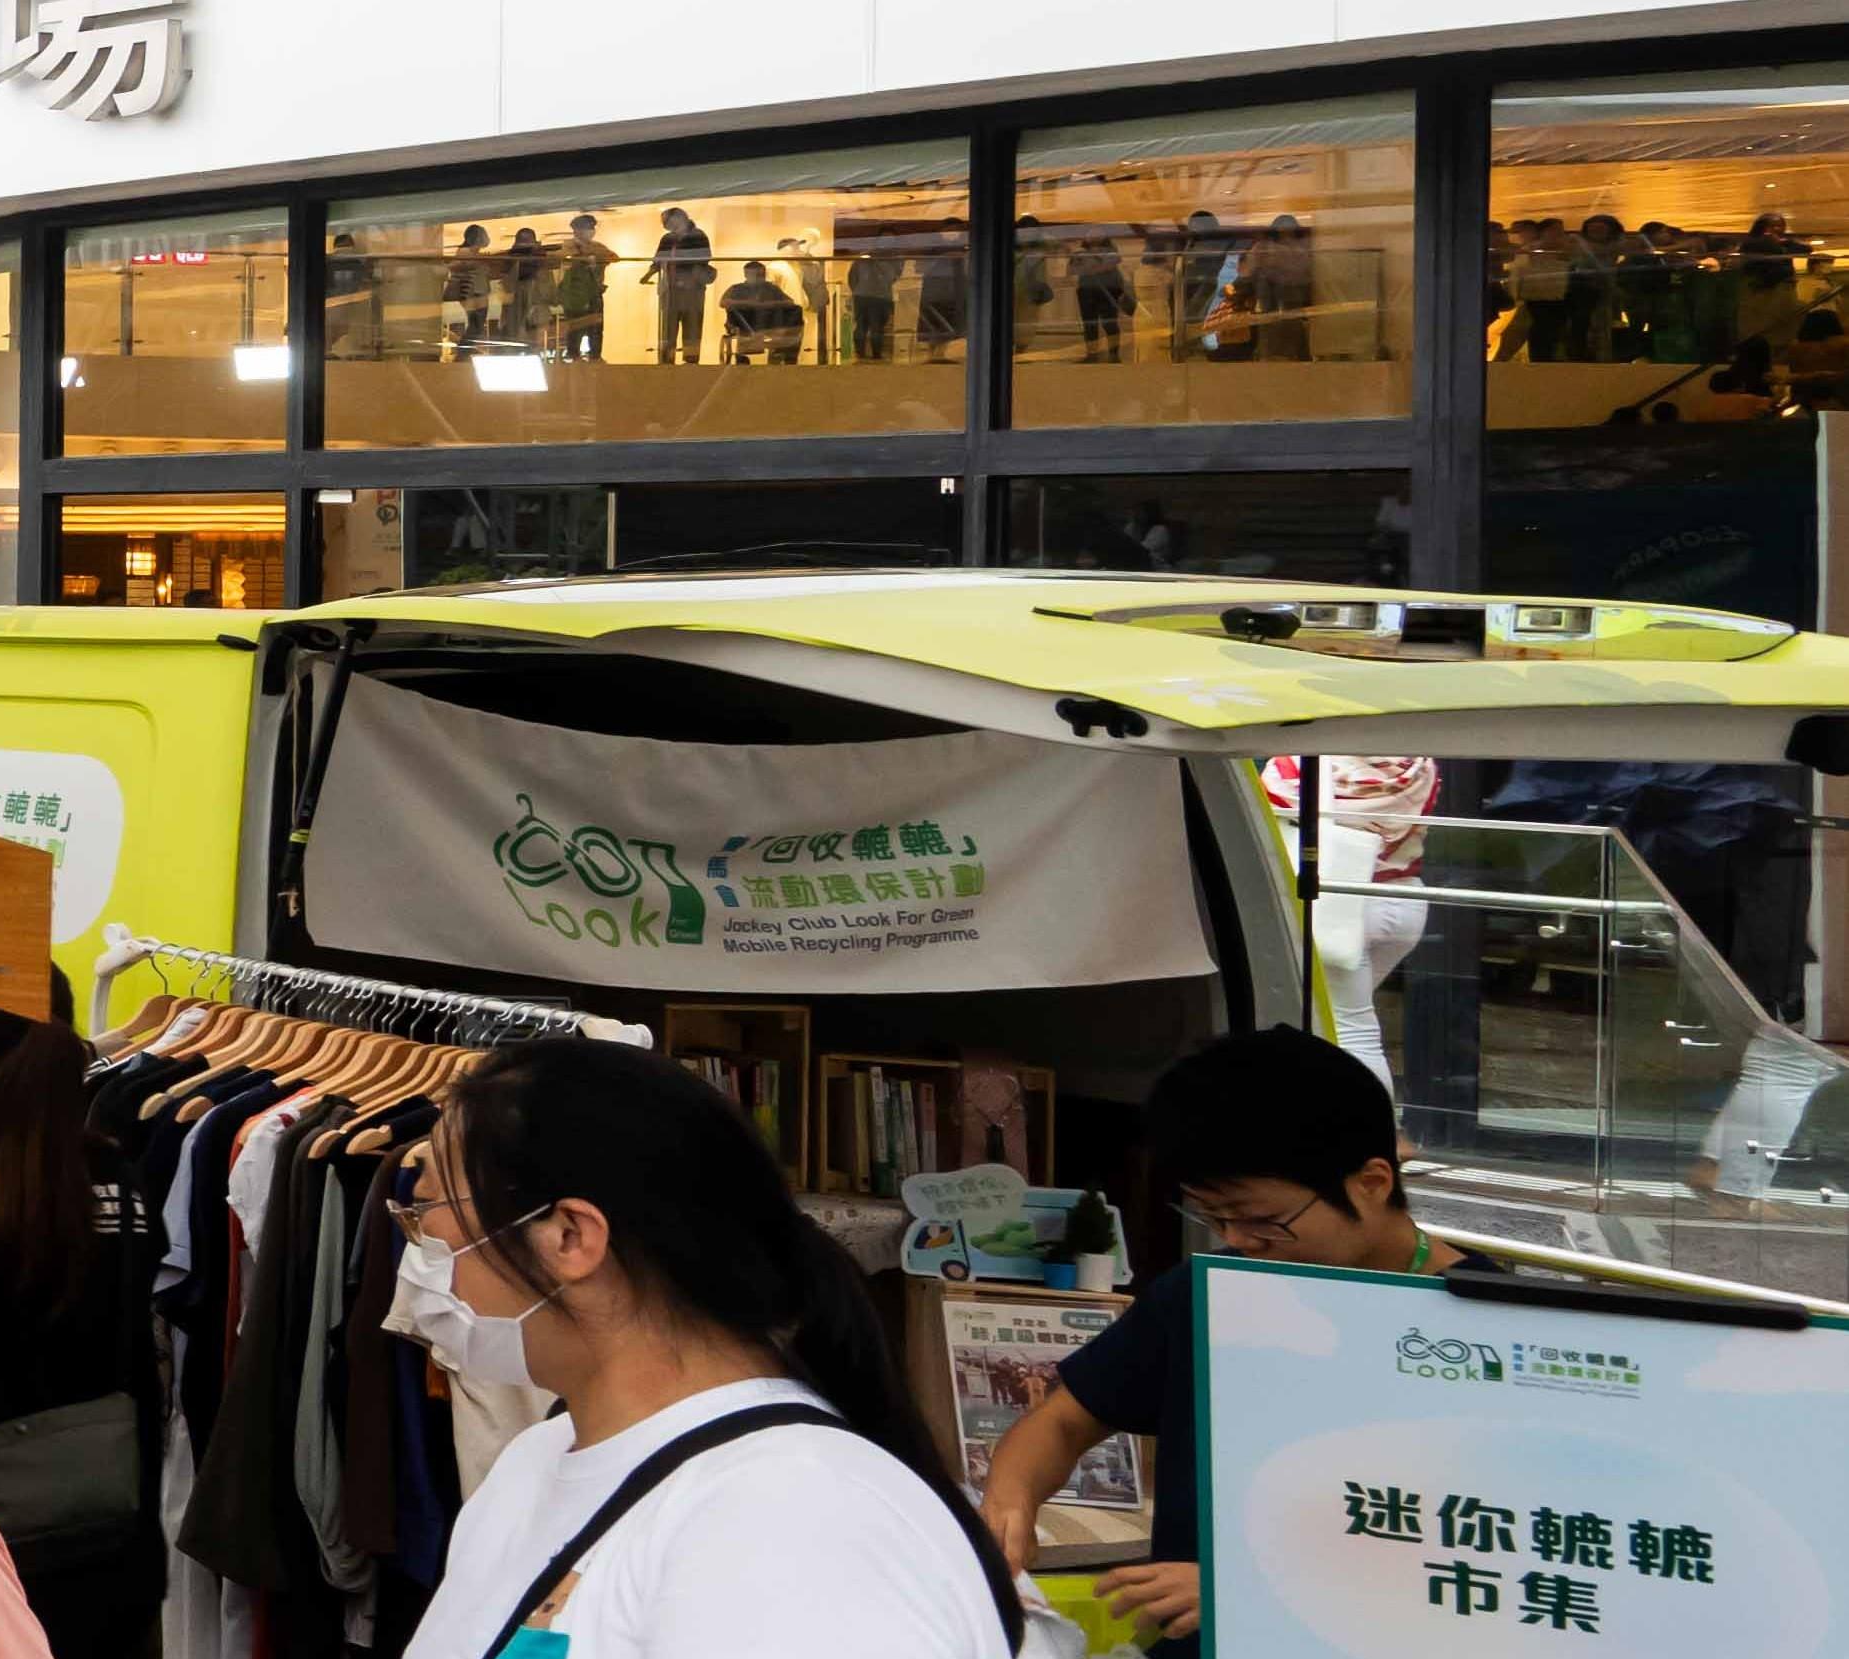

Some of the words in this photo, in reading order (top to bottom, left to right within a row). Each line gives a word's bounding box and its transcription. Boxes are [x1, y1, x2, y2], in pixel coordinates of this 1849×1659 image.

[742, 861, 985, 909] 流動環保計劃
[723, 918, 783, 936] Jockey
[788, 915, 837, 931] Club
[841, 911, 890, 929] Look
[897, 909, 925, 926] For
[931, 907, 974, 923] Green
[723, 937, 787, 954] Mobile
[793, 932, 882, 955] Recycling
[886, 926, 980, 949] Programme
[1397, 1356, 1480, 1382] Look
[1344, 1481, 1715, 1585] 迷你轆轆
[1424, 1560, 1602, 1634] 市集
